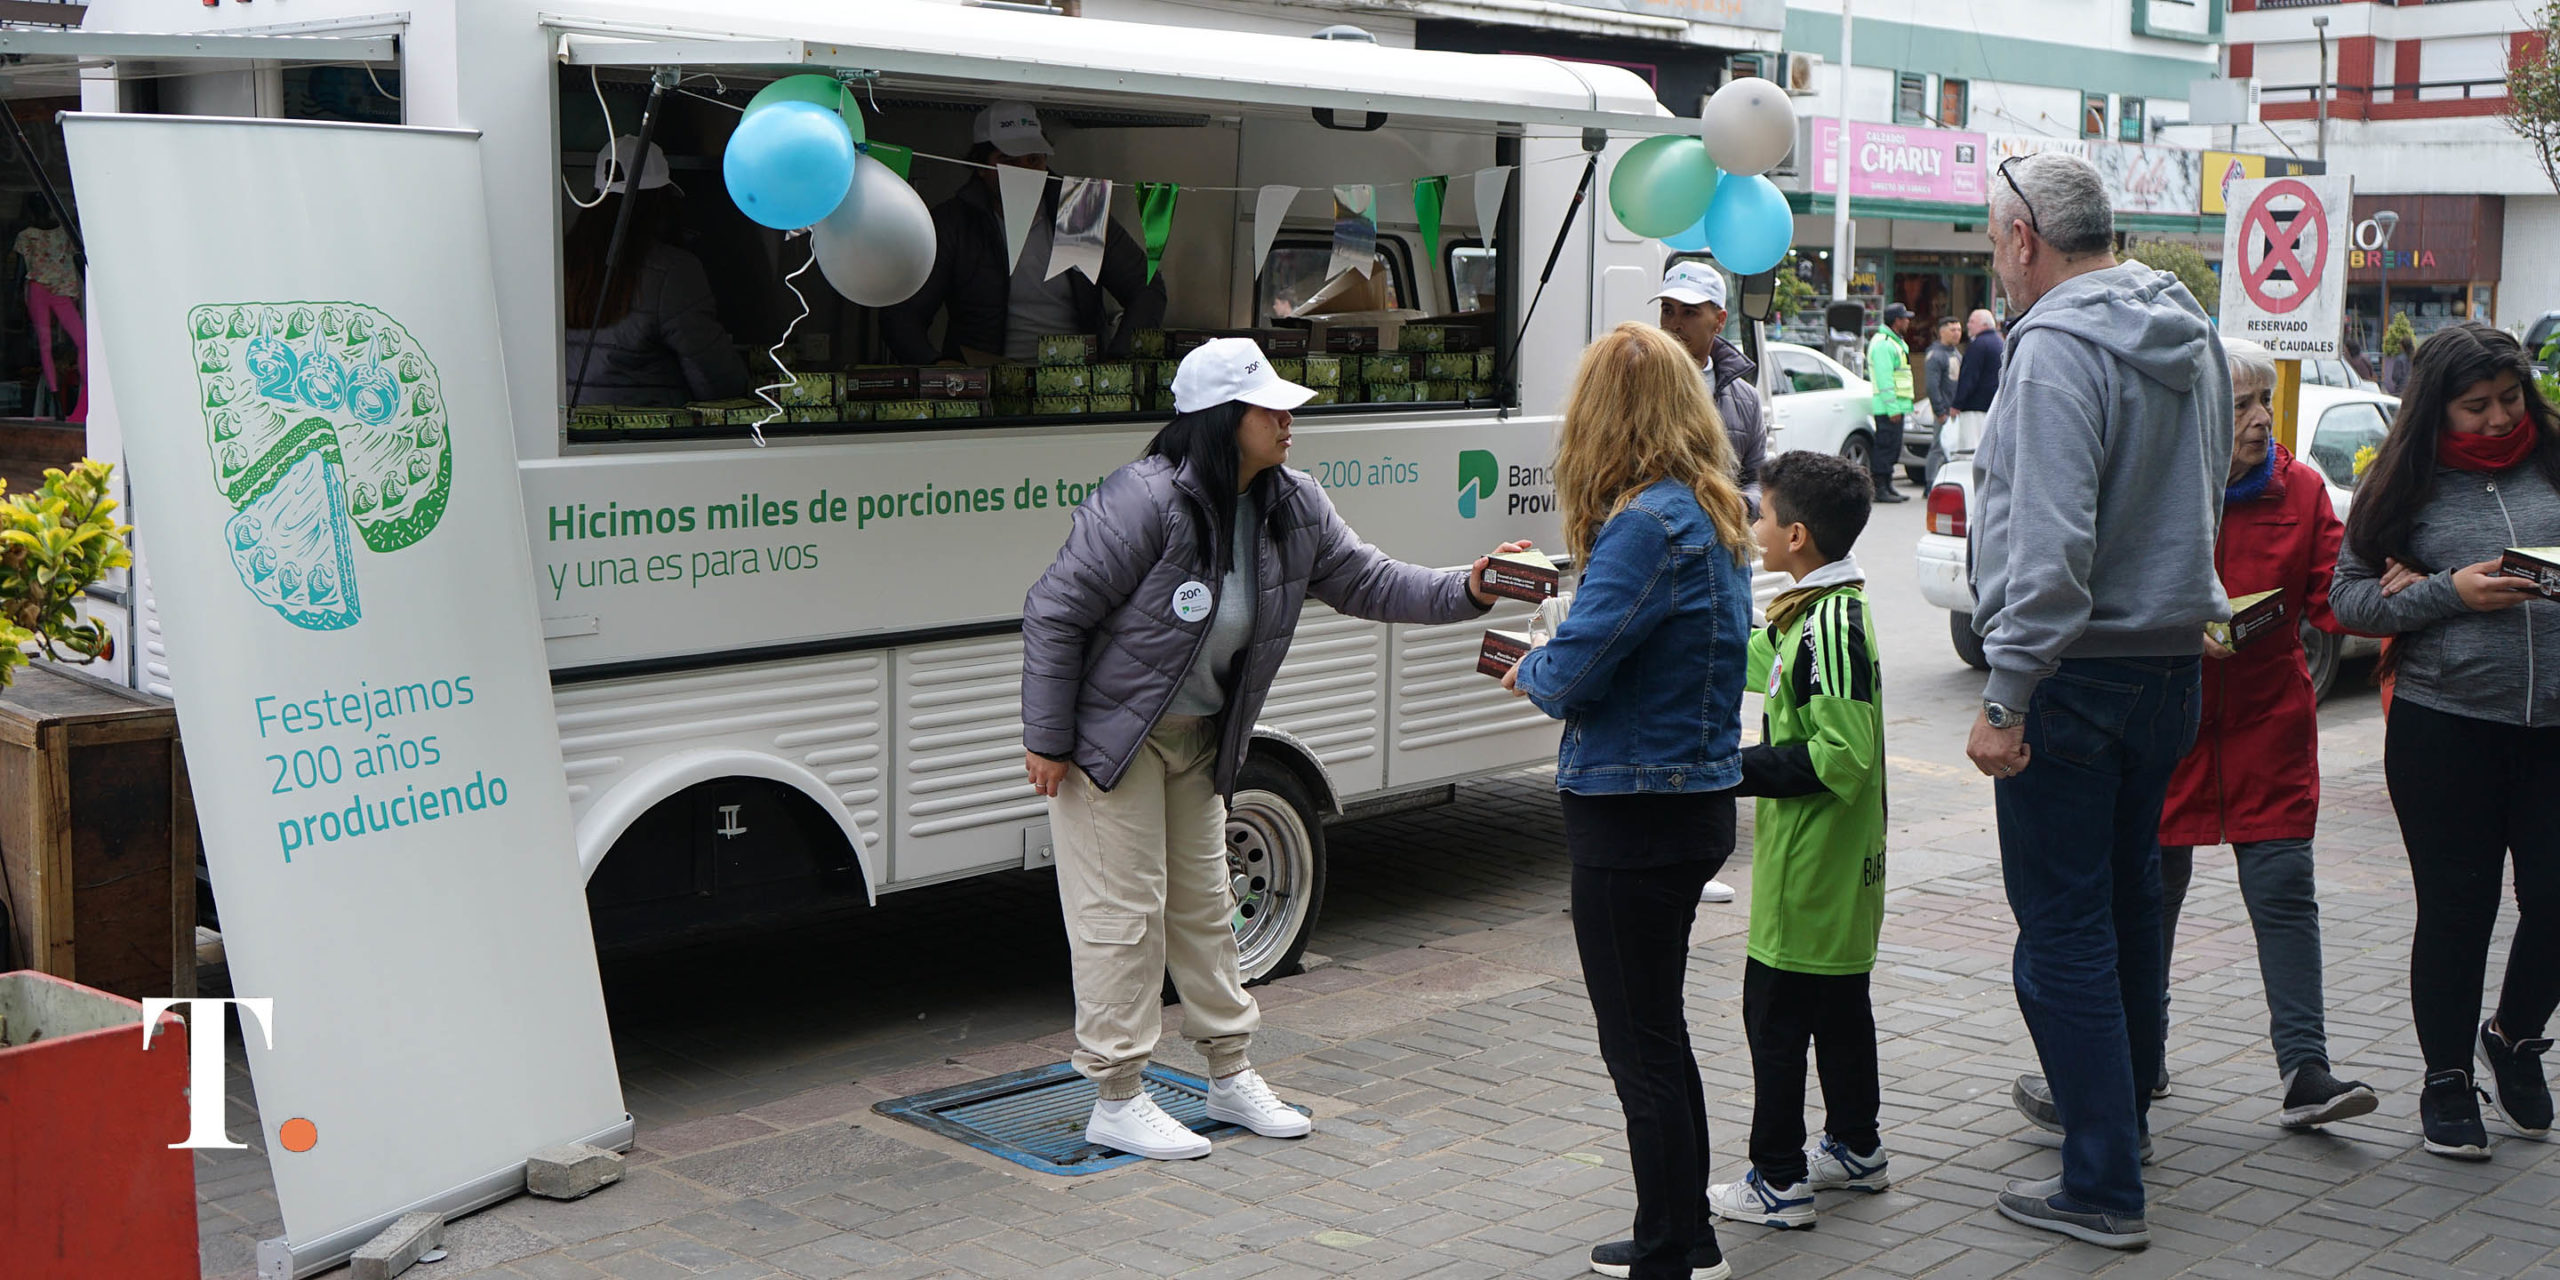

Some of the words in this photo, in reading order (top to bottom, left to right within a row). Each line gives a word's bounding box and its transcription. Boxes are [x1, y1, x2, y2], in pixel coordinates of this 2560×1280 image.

[1866, 131, 1906, 145] CALZADOS
[1860, 142, 1942, 177] CHARLY
[2350, 249, 2436, 269] BRERIA
[2248, 320, 2308, 332] RESERVADO
[2263, 340, 2277, 351] DE
[2279, 341, 2334, 352] CAUDALES
[1318, 459, 1362, 489] 200
[1367, 456, 1419, 486] años
[1508, 465, 1554, 488] Banc
[549, 501, 696, 541] Hicimos
[708, 493, 798, 530] miles
[808, 489, 847, 523] de
[858, 483, 1005, 530] porciones
[1014, 477, 1048, 510] de
[1508, 490, 1556, 516] Provi
[548, 563, 567, 600] y
[577, 557, 639, 588] una
[646, 554, 683, 582] es
[692, 548, 760, 589] para
[767, 544, 819, 572] vos
[255, 675, 474, 738] Festejamos
[265, 745, 343, 795] 200
[353, 733, 441, 778] años
[278, 770, 508, 863] produciendo
